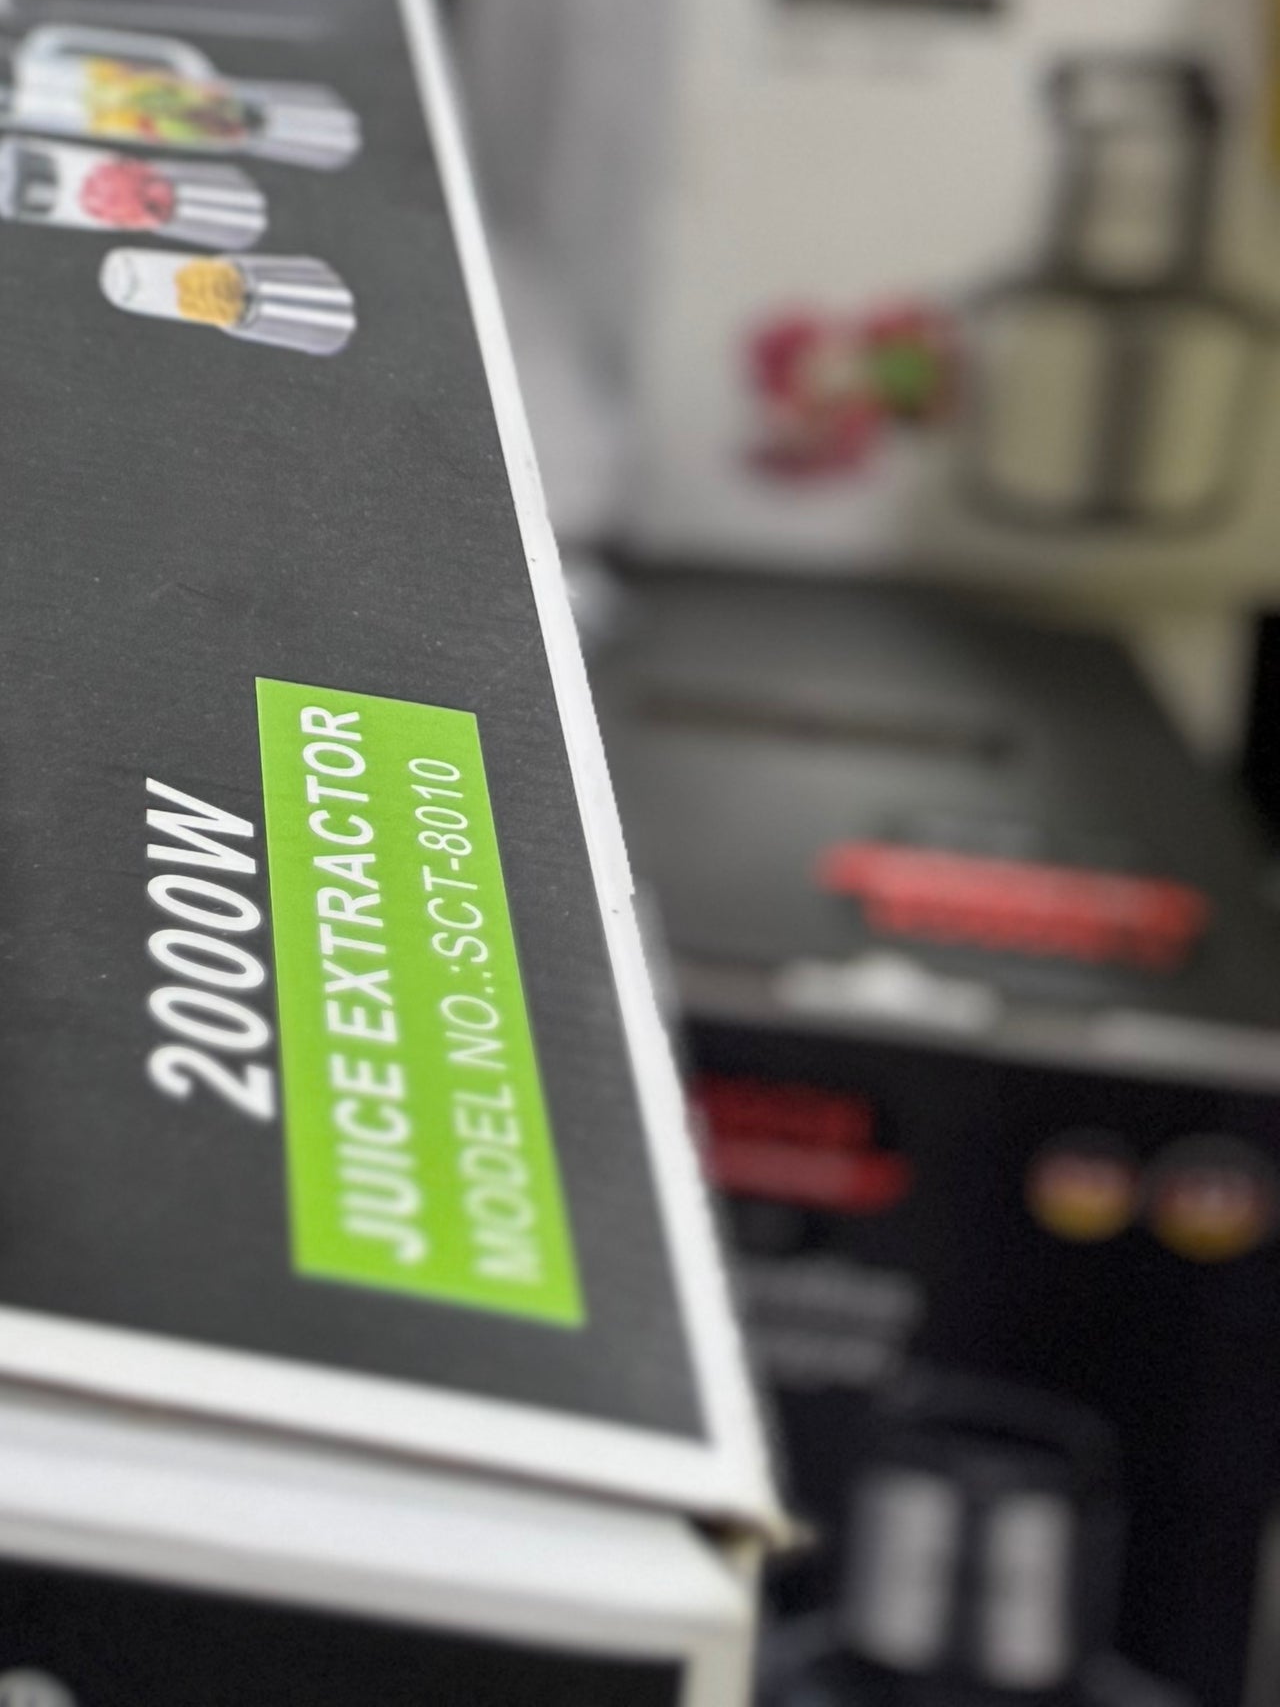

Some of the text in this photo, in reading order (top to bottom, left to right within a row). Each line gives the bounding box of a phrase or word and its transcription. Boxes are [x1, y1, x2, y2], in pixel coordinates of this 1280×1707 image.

[145, 777, 277, 1121] 2000W
[299, 706, 428, 1266] JUICE EXTRACTOR
[454, 1083, 543, 1285] MODEL
